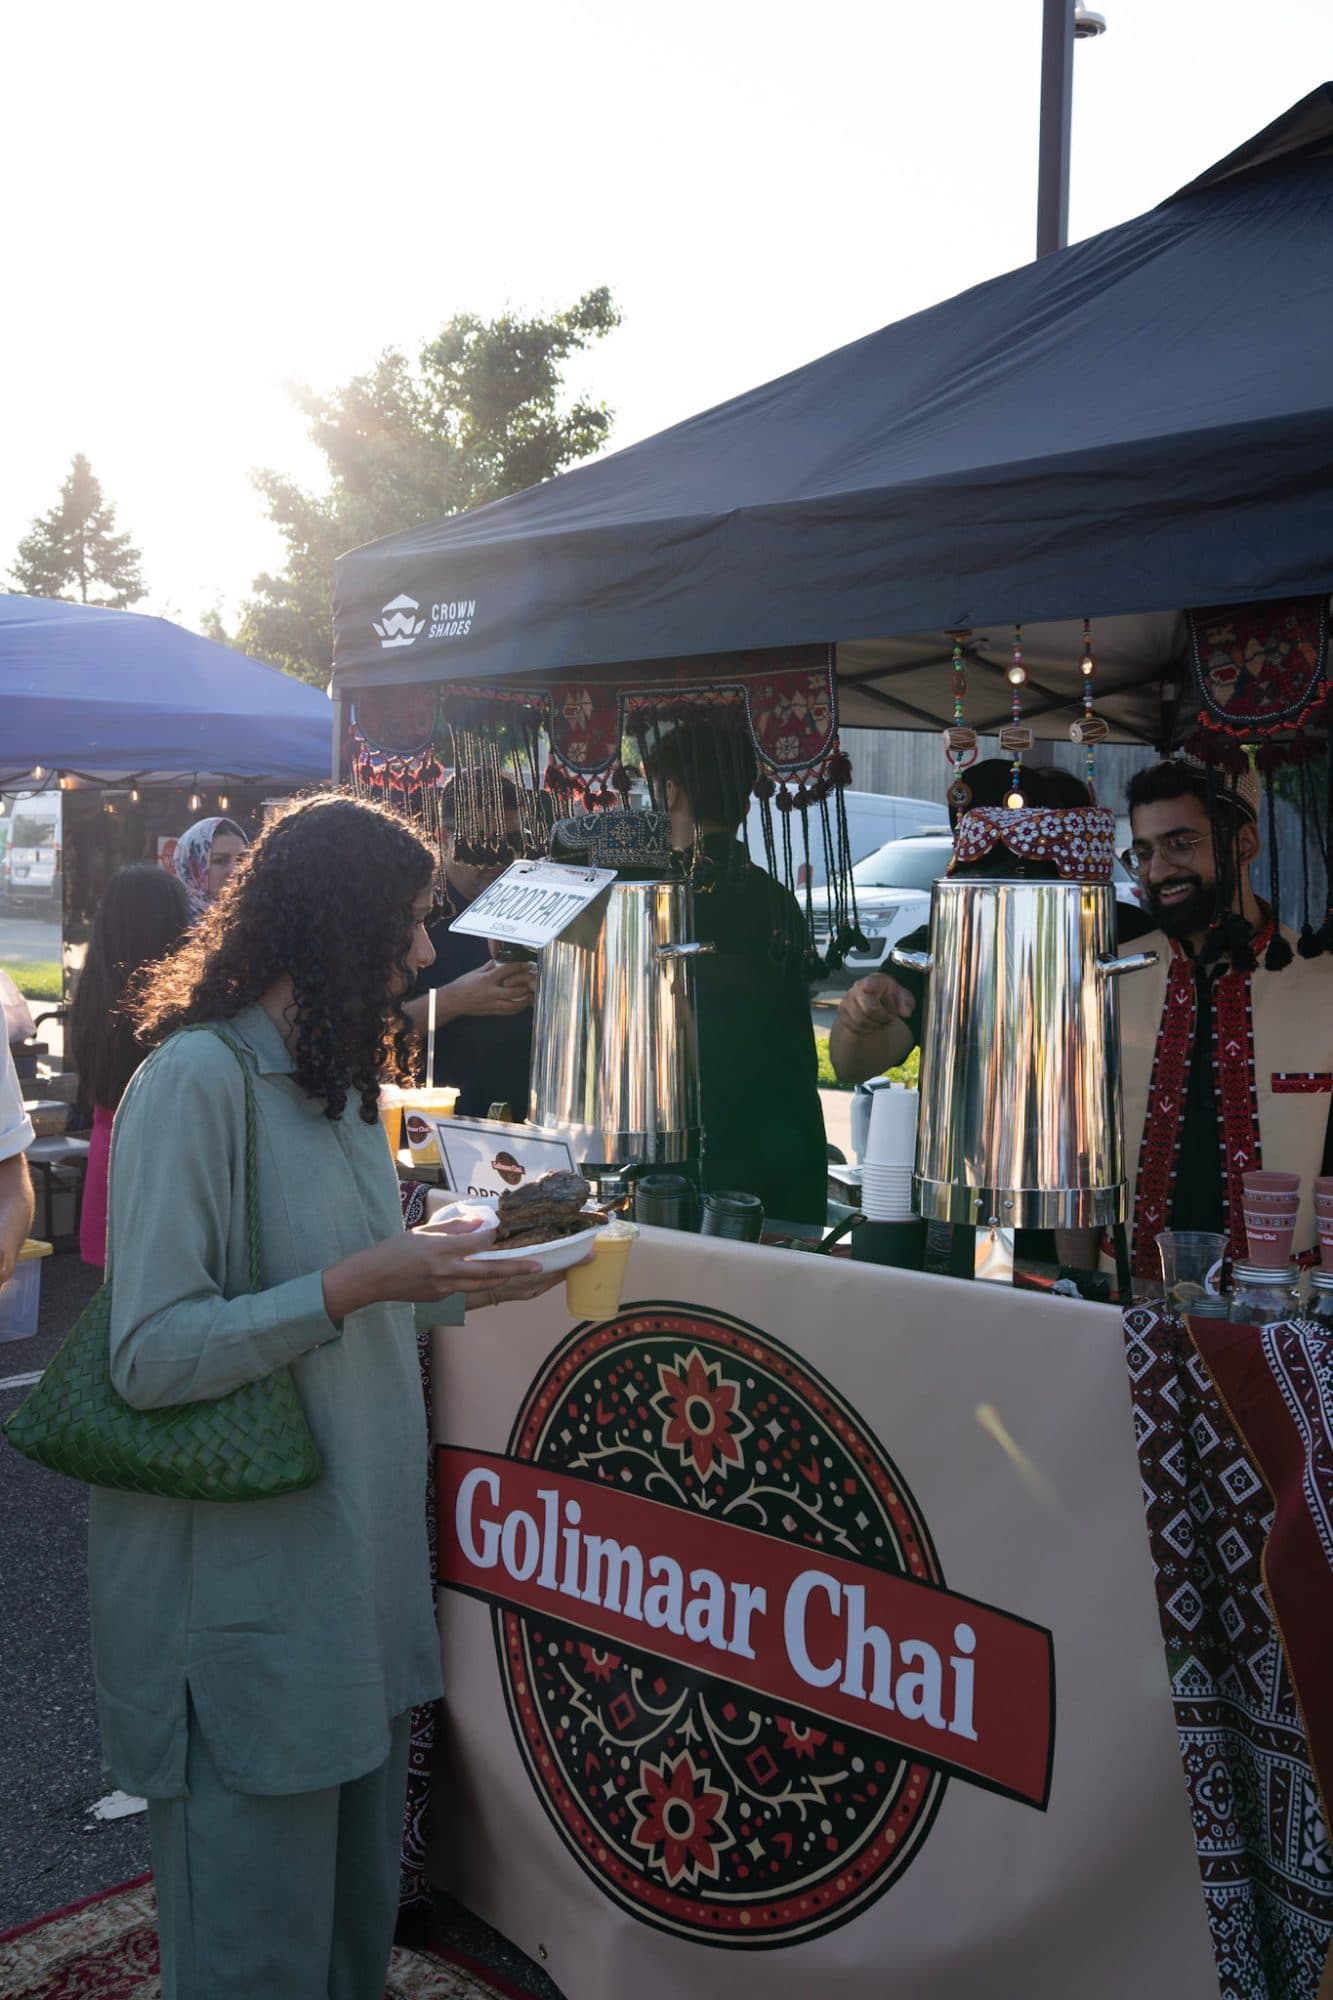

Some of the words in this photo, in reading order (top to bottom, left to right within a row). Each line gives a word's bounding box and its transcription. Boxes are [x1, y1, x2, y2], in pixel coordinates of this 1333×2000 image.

[431, 600, 476, 621] CROWN
[428, 619, 472, 639] SHADES
[469, 882, 549, 921] BAROOD
[455, 1468, 767, 1660] Golimaar
[783, 1570, 979, 1741] Chai
